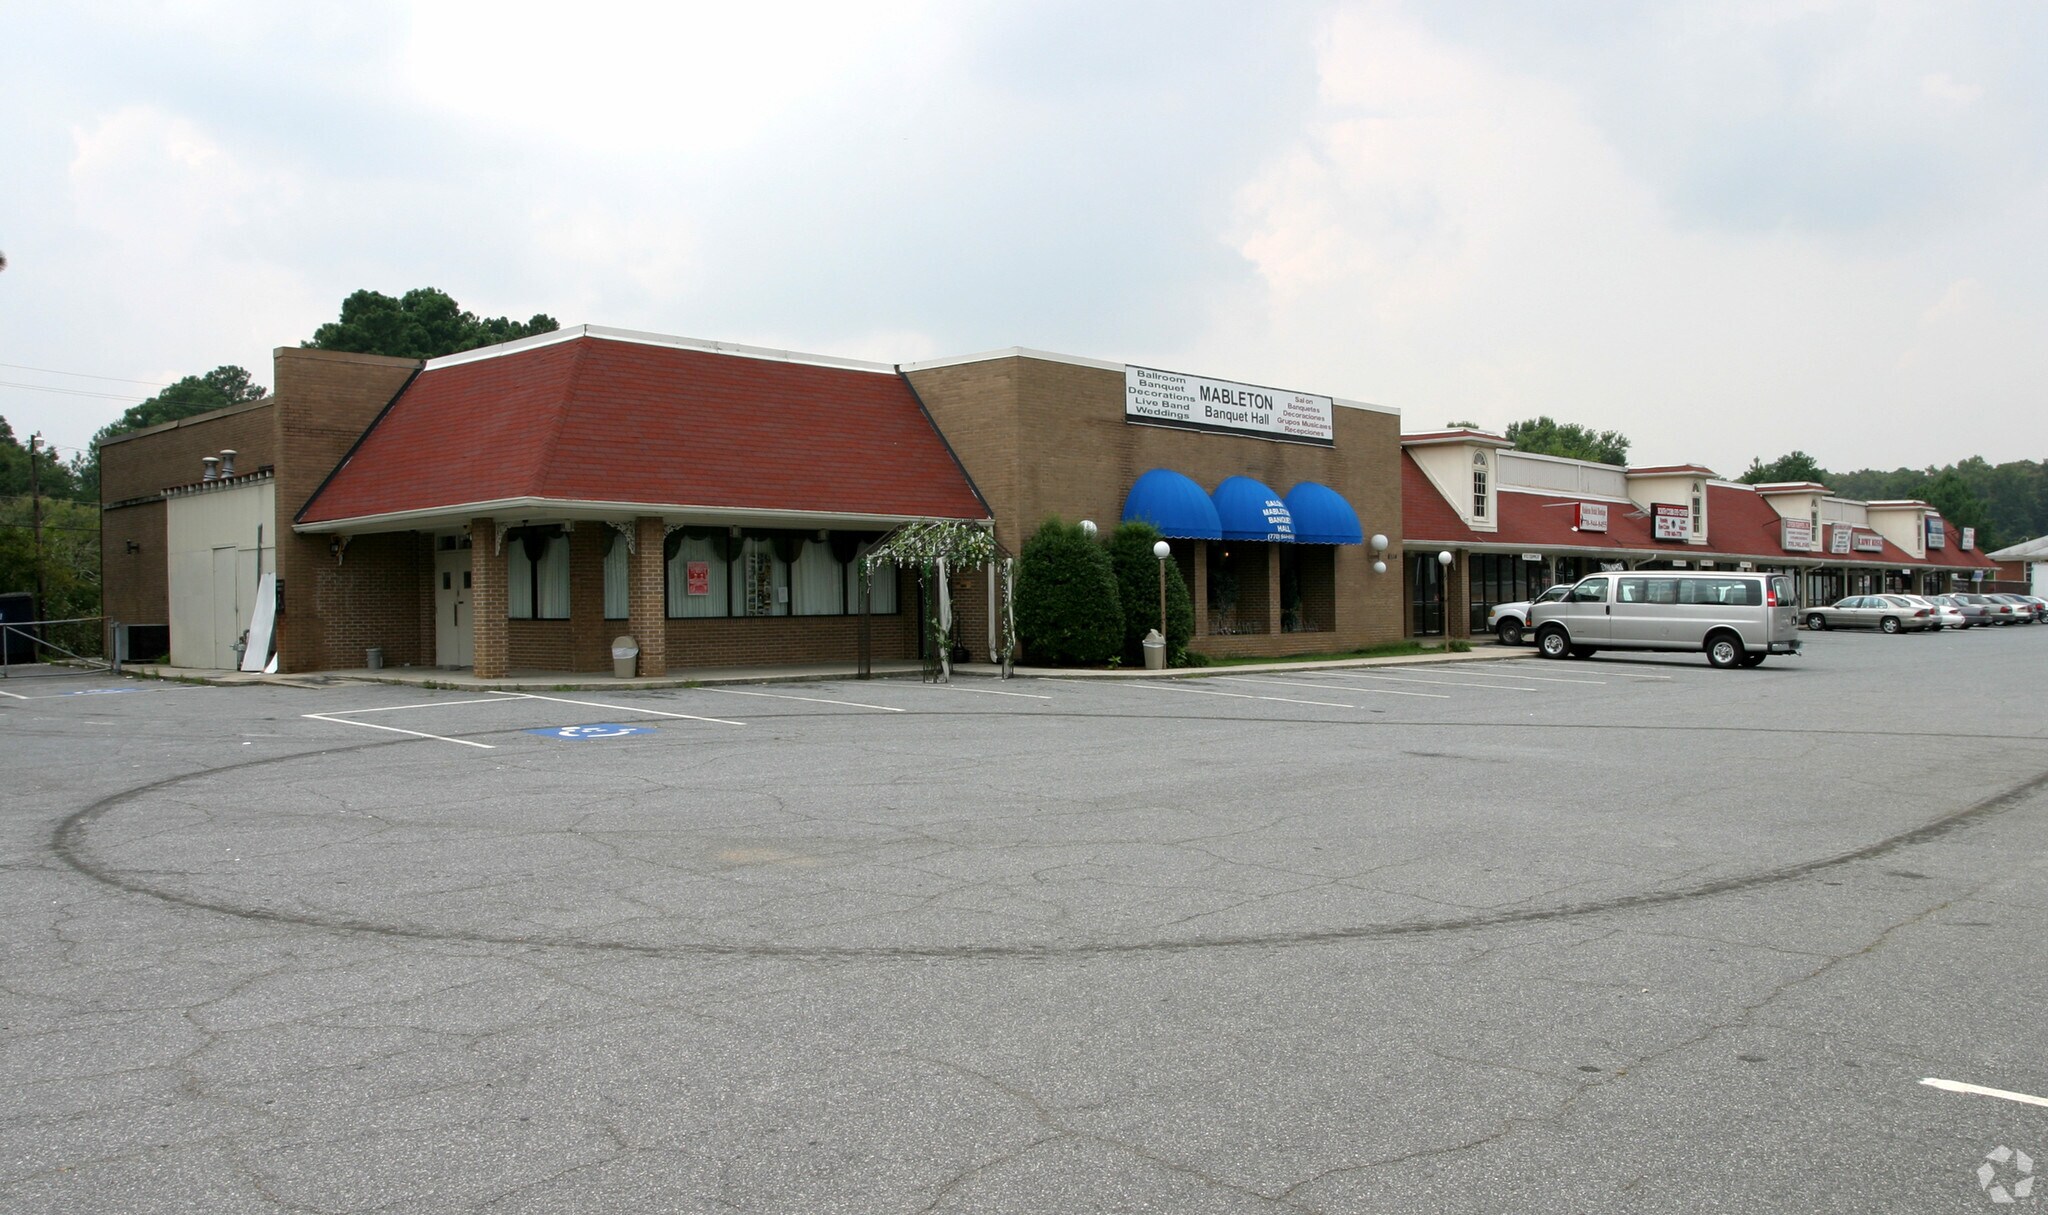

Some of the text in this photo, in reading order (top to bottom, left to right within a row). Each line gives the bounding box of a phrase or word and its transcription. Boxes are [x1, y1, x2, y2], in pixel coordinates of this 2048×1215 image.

[1137, 370, 1186, 384] Ballroom
[1139, 379, 1185, 393] Banquet
[1128, 386, 1196, 402] Decorations
[1199, 385, 1273, 411] MABLETON
[1135, 397, 1190, 411] Live Band
[1287, 403, 1320, 413] Banquetes
[1136, 406, 1190, 419] Weddings
[1205, 405, 1269, 425] Banquet Hall
[1282, 410, 1325, 421] Decoraciones
[1277, 417, 1301, 427] Grupos
[1284, 426, 1324, 437] Recepciones
